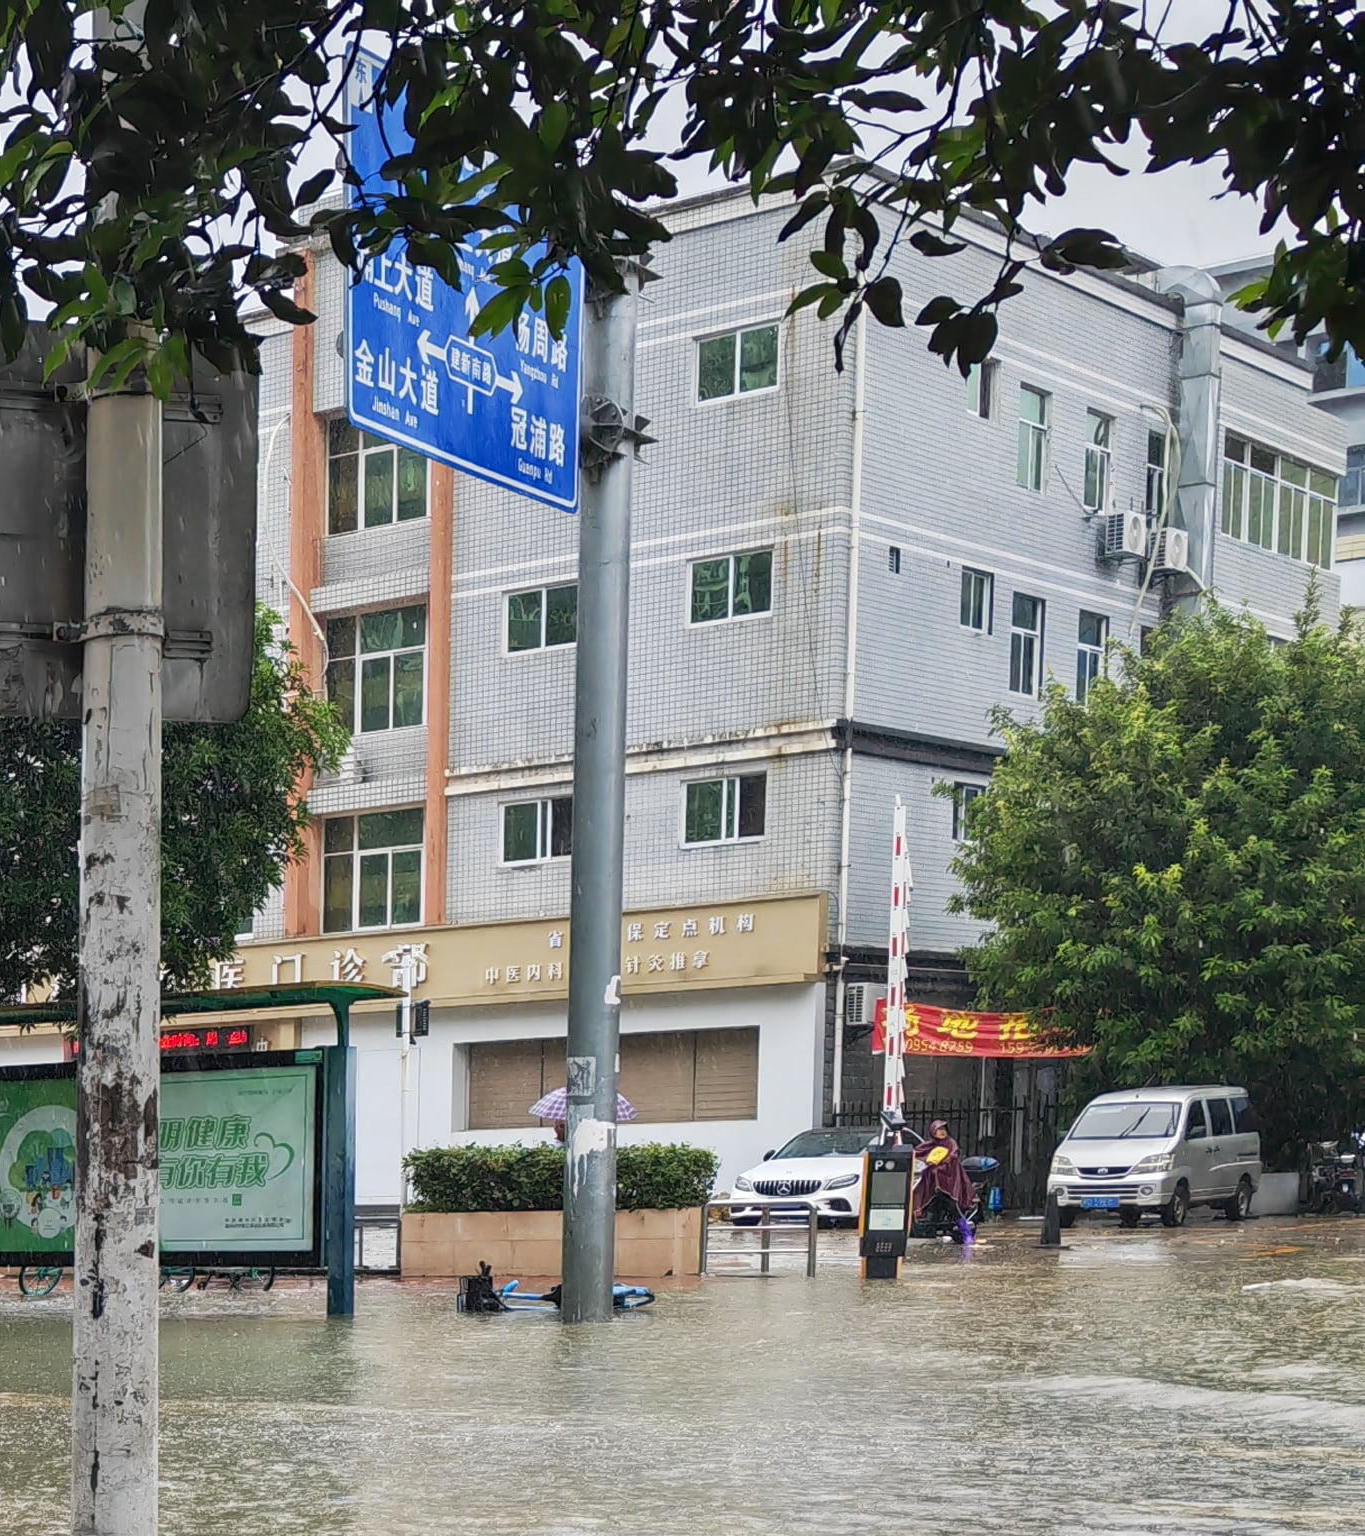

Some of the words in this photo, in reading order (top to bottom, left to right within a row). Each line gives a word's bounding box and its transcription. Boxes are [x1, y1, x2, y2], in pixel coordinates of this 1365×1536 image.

[372, 291, 402, 322] Pushang
[354, 338, 440, 417] 金山大道
[449, 346, 492, 386] 建新南路
[372, 395, 401, 422] Jinshan
[405, 404, 419, 429] Ave
[510, 406, 565, 468] 冠浦路
[484, 961, 564, 986] 中医内科
[624, 950, 710, 975] 针灸推拿
